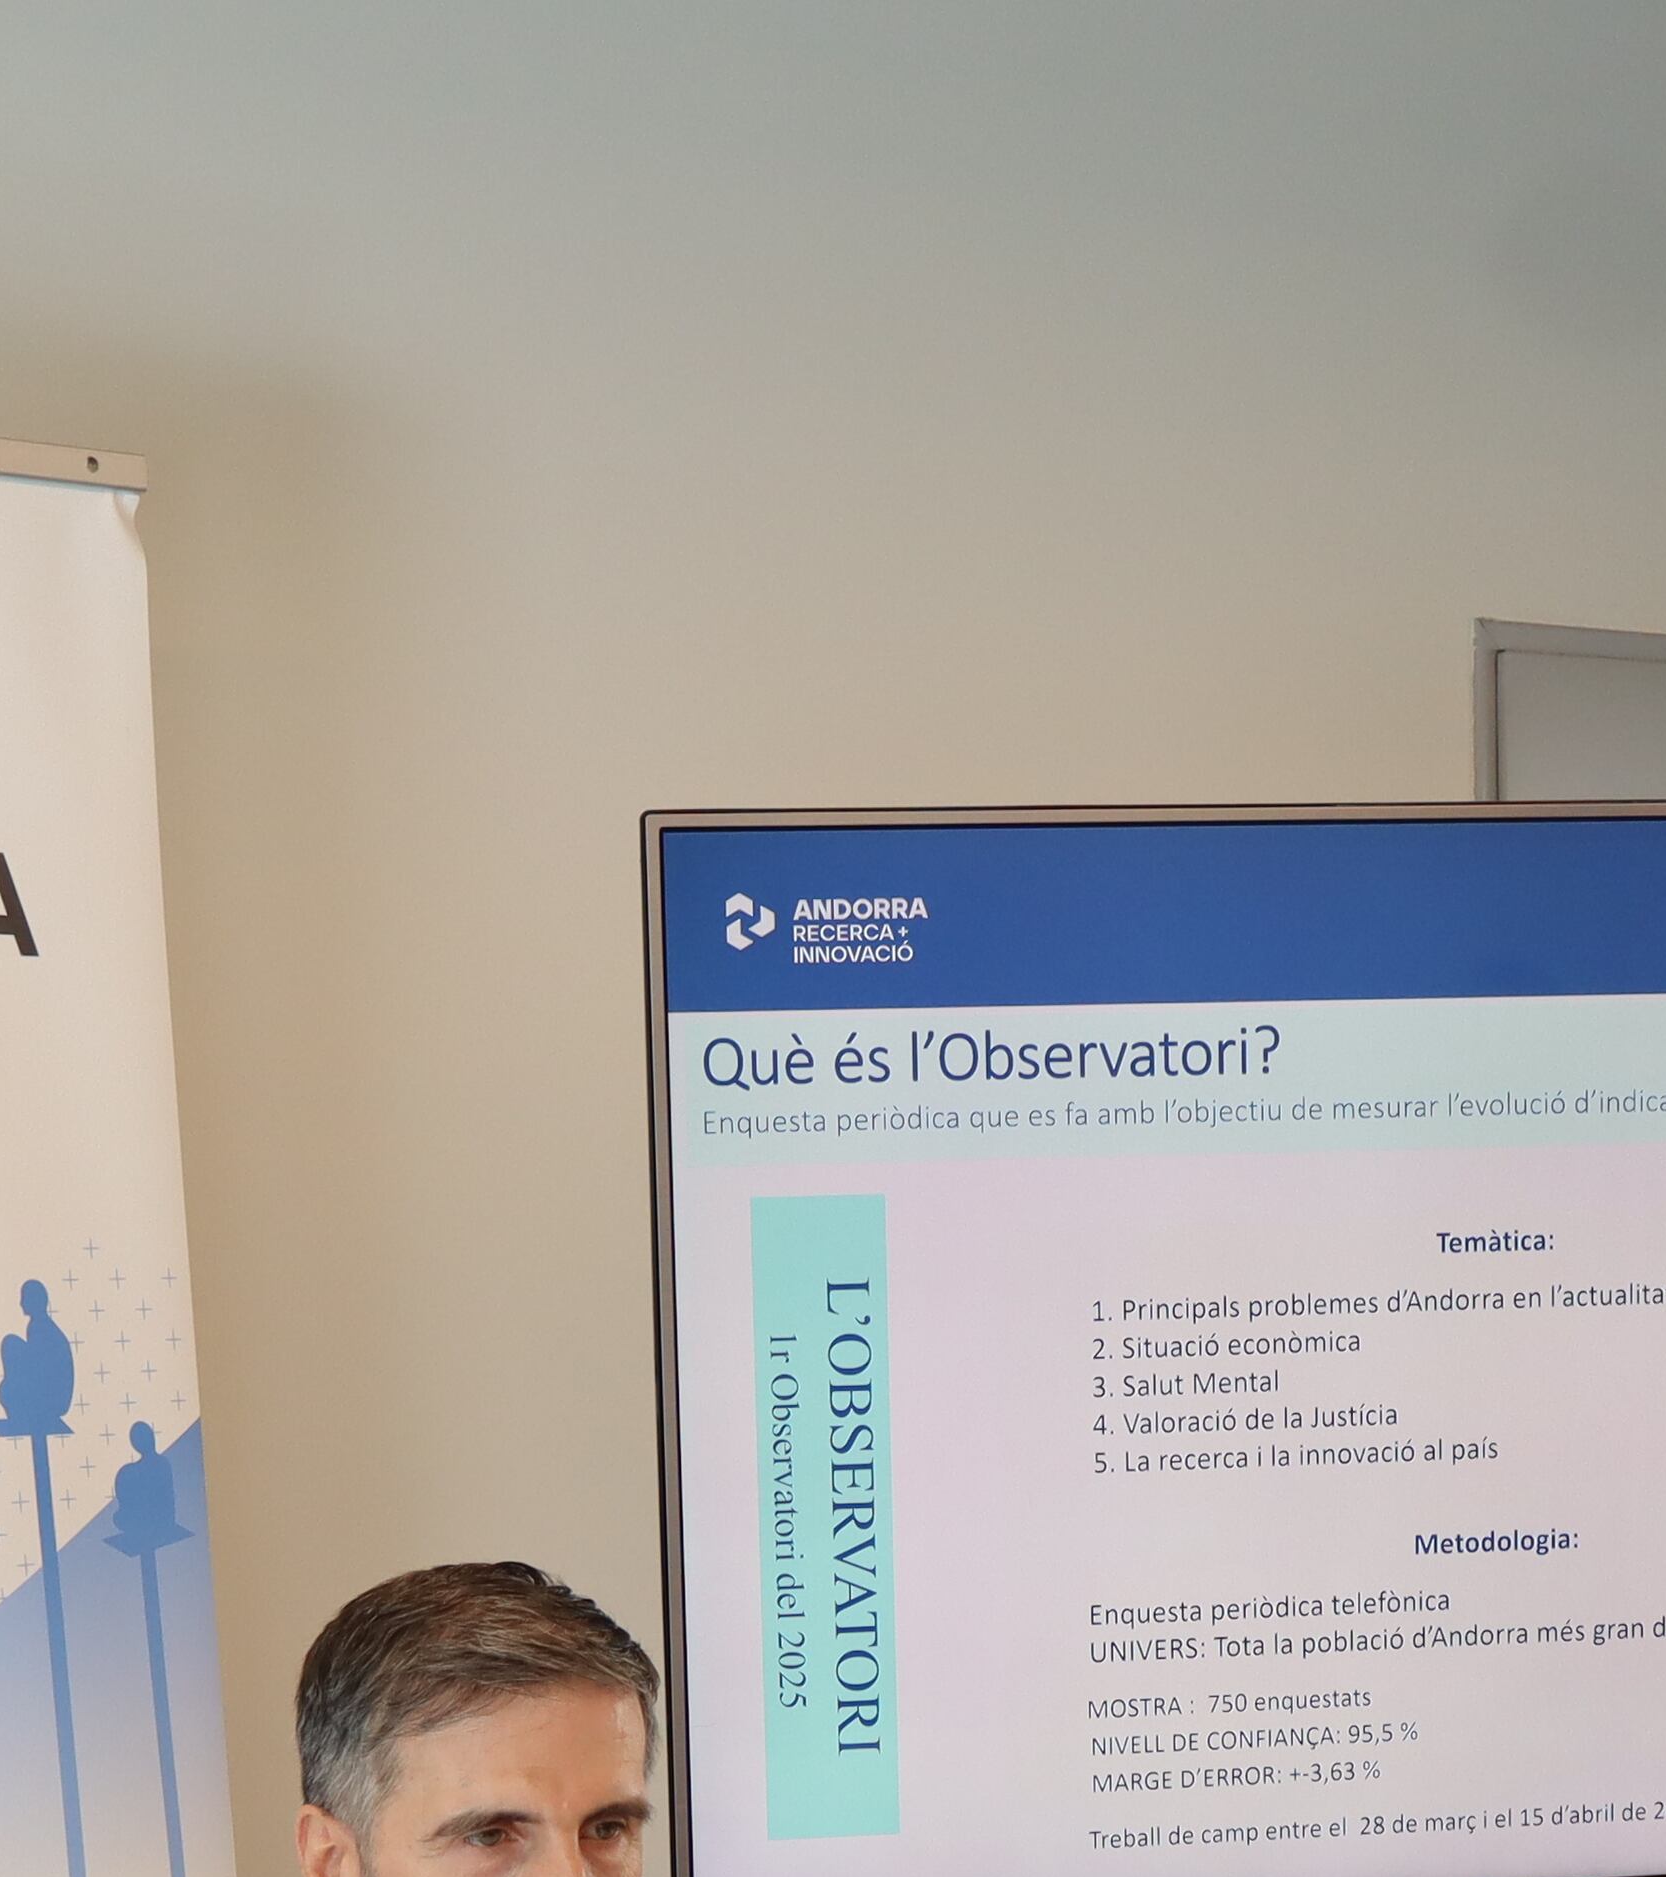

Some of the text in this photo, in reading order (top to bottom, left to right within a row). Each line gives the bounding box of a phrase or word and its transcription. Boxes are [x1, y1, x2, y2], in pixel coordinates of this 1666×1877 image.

[794, 898, 928, 920] ANDORRA
[794, 924, 894, 941] RECERCA
[794, 940, 913, 963] INNOVACIÓ
[704, 1025, 1279, 1091] Què és l’Observatori?
[704, 1111, 825, 1139] Enquesta
[838, 1105, 959, 1136] periòdica
[970, 1110, 1018, 1133] que
[1029, 1110, 1055, 1126] es
[1066, 1101, 1087, 1125] fa
[1098, 1100, 1154, 1125] amb
[1165, 1099, 1281, 1128] l’objectiu
[1292, 1097, 1322, 1120] de
[1333, 1101, 1438, 1119] mesurar
[1449, 1090, 1565, 1116] l’evolució
[1437, 1230, 1553, 1253] Temàtica:
[1093, 1301, 1112, 1322] 1.
[1123, 1296, 1239, 1324] Principals
[1249, 1293, 1378, 1322] problemes
[1387, 1289, 1503, 1312] d’Andorra
[1513, 1292, 1541, 1309] en
[1093, 1331, 1360, 1359] 2. Situació econòmica
[1094, 1370, 1278, 1398] 3. Salut Mental
[1093, 1404, 1397, 1435] 4. Valoració de la Justícia
[1095, 1437, 1498, 1473] 5. La recerca i la innovació al país
[770, 1336, 806, 1707] 1r Observatori del 2025
[826, 1278, 882, 1757] L’OBSERVATORI
[1415, 1529, 1577, 1555] Metodologia:
[1091, 1591, 1449, 1629] Enquesta periòdica telefònica
[1091, 1638, 1204, 1663] UNIVERS:
[1214, 1636, 1264, 1657] Tota
[1275, 1633, 1292, 1654] la
[1303, 1627, 1403, 1659] població
[1413, 1624, 1527, 1648] d’Andorra
[1538, 1620, 1585, 1642] més
[1593, 1622, 1643, 1646] gran
[1089, 1697, 1182, 1718] MOSTRA
[1209, 1693, 1247, 1713] 750
[1255, 1690, 1371, 1714] enquestats
[1092, 1722, 1418, 1755] NIVELL DE CONFIANÇA: 95,5 %
[1093, 1761, 1380, 1792] MARGE D’ERROR: +-3,63 %
[1089, 1827, 1160, 1849] Treball
[1169, 1826, 1193, 1845] de
[1202, 1827, 1258, 1846] camp
[1266, 1822, 1321, 1840] entre
[1329, 1817, 1346, 1837] el
[1361, 1816, 1385, 1835] 28
[1392, 1814, 1417, 1834] de
[1426, 1815, 1475, 1834] març
[1484, 1810, 1487, 1828] i
[1495, 1809, 1511, 1828] el
[1521, 1808, 1543, 1826] 15
[1552, 1803, 1614, 1825] d’abril
[1622, 1802, 1646, 1821] de
